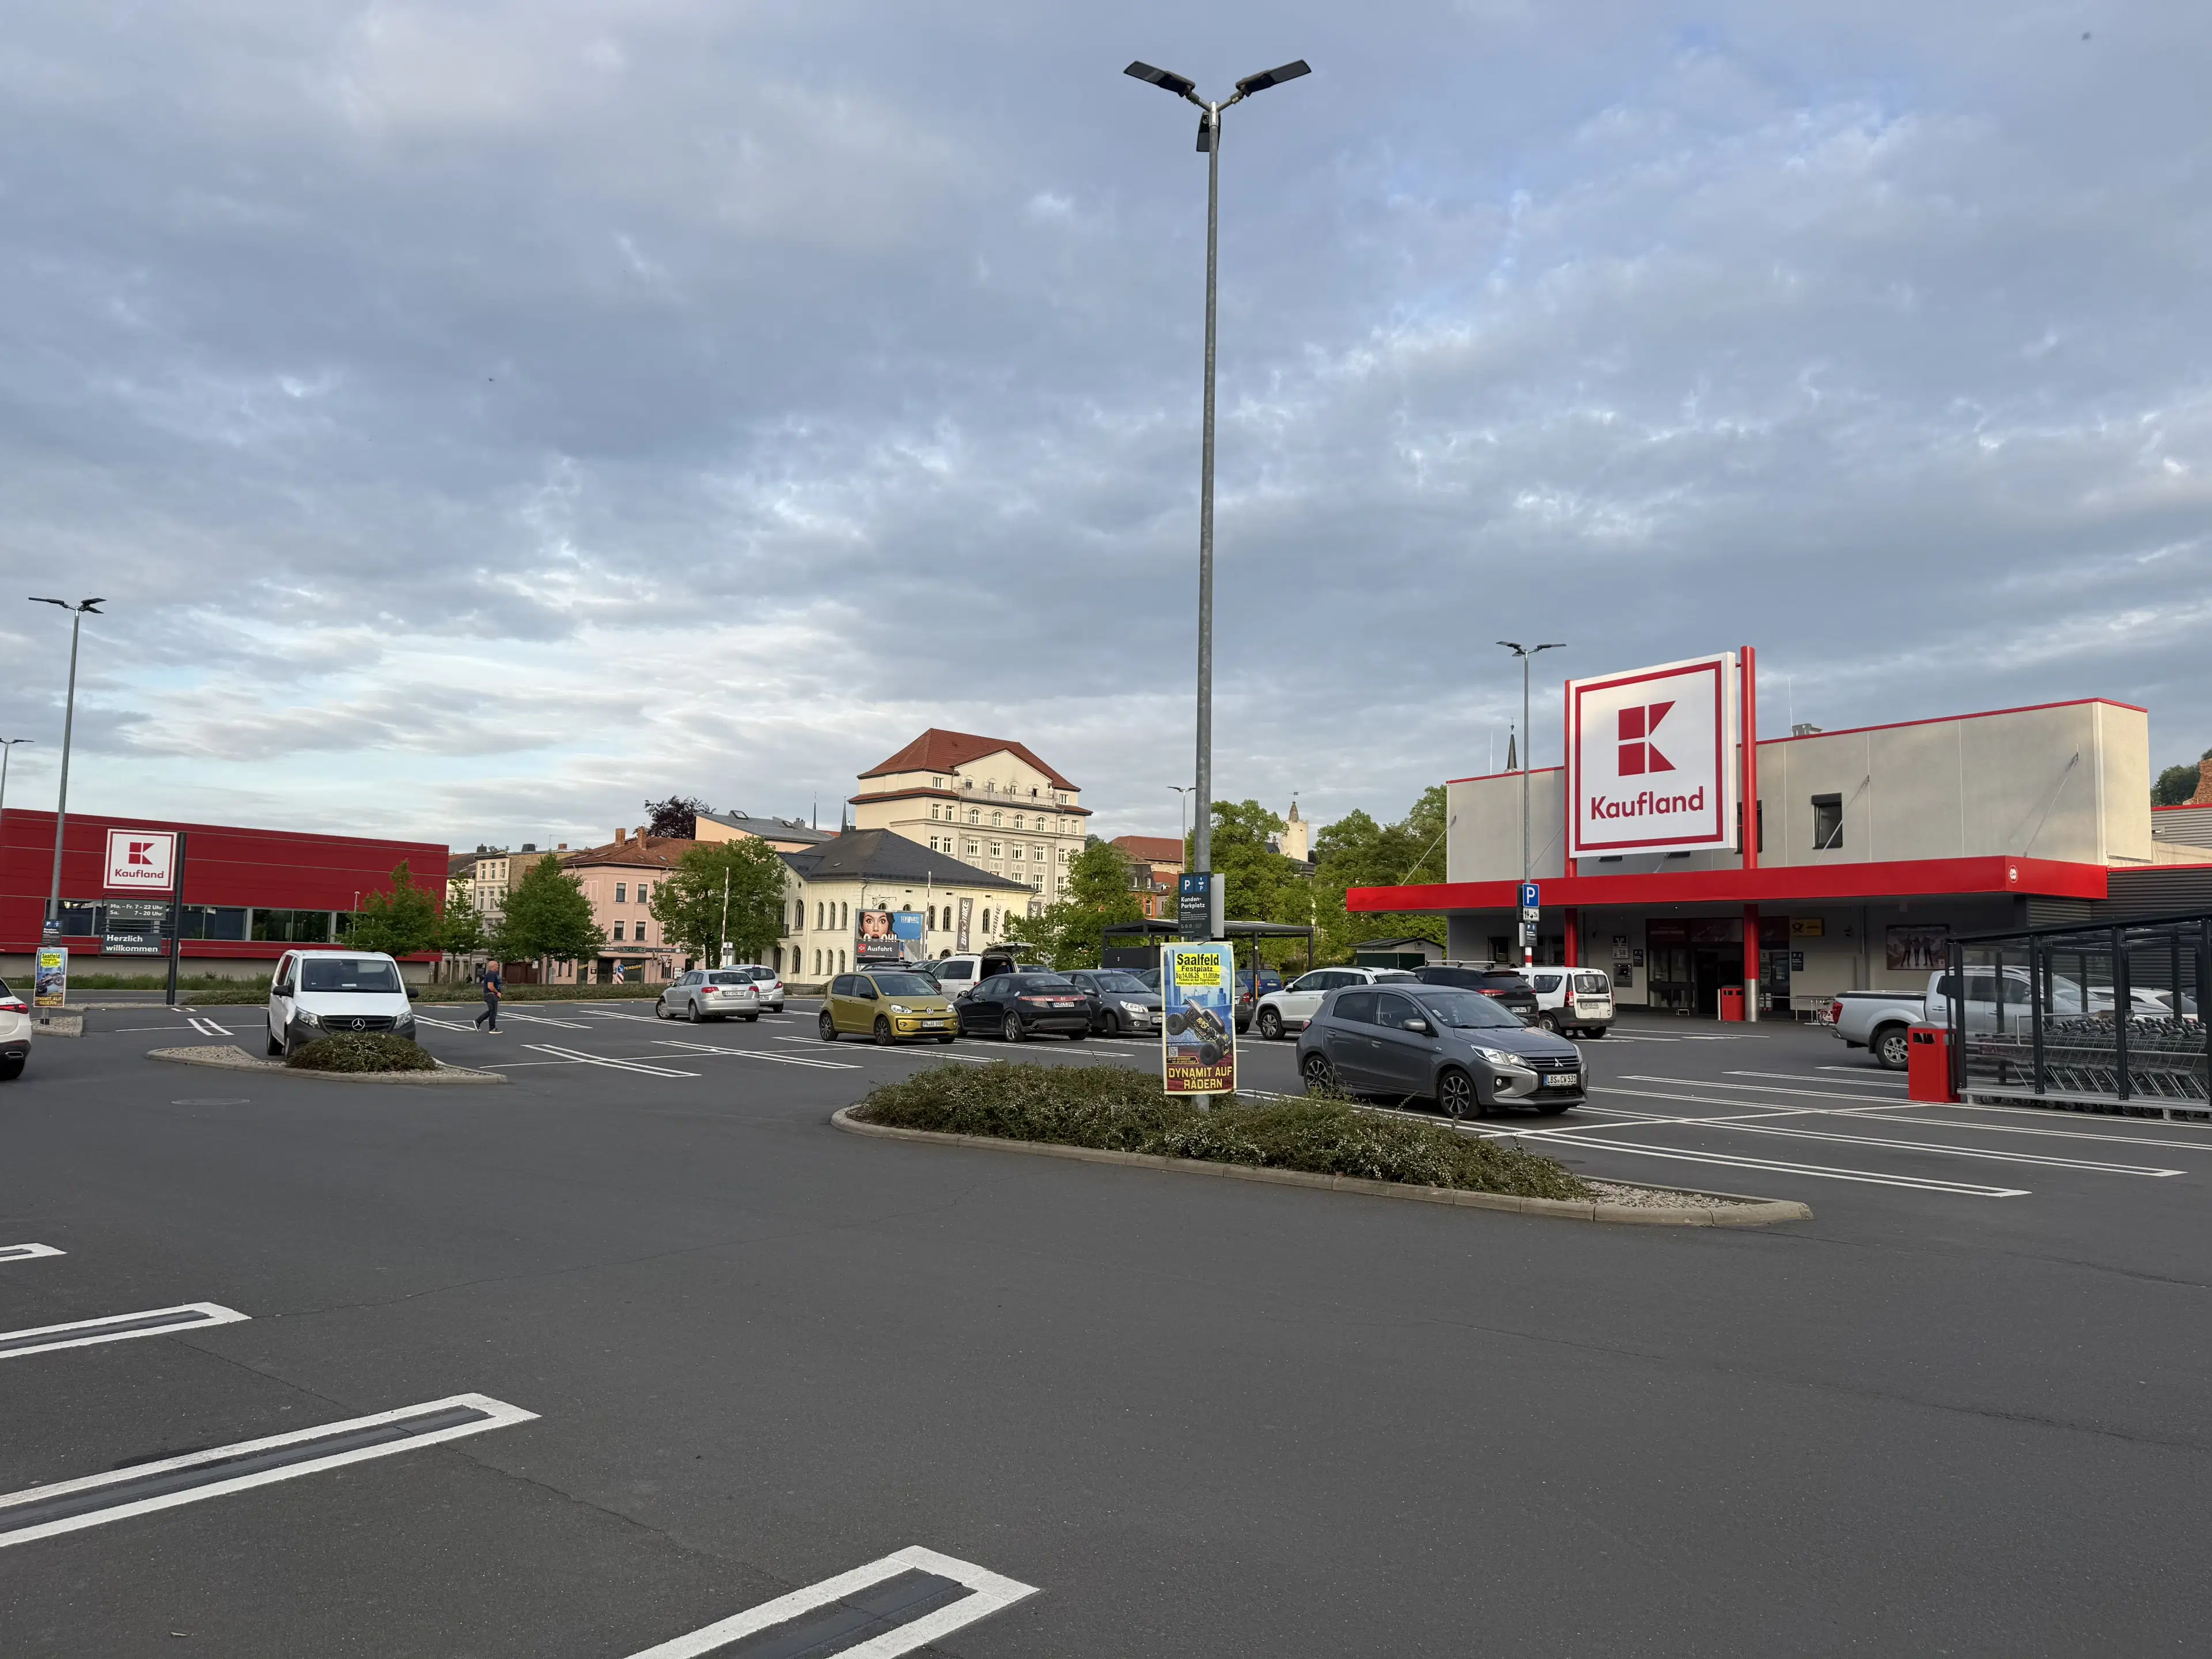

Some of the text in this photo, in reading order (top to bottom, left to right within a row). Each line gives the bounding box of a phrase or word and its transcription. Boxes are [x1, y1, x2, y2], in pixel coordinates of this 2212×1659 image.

[1591, 786, 1703, 820] Kaufland
[115, 869, 164, 878] Kaufland
[1184, 880, 1190, 890] P
[1527, 887, 1535, 904] P
[1177, 953, 1219, 965] Saalfeld
[1168, 1066, 1233, 1078] DYNAMIT AUF
[1184, 1077, 1222, 1089] RÄDERN
[1567, 1075, 1576, 1083] 531
